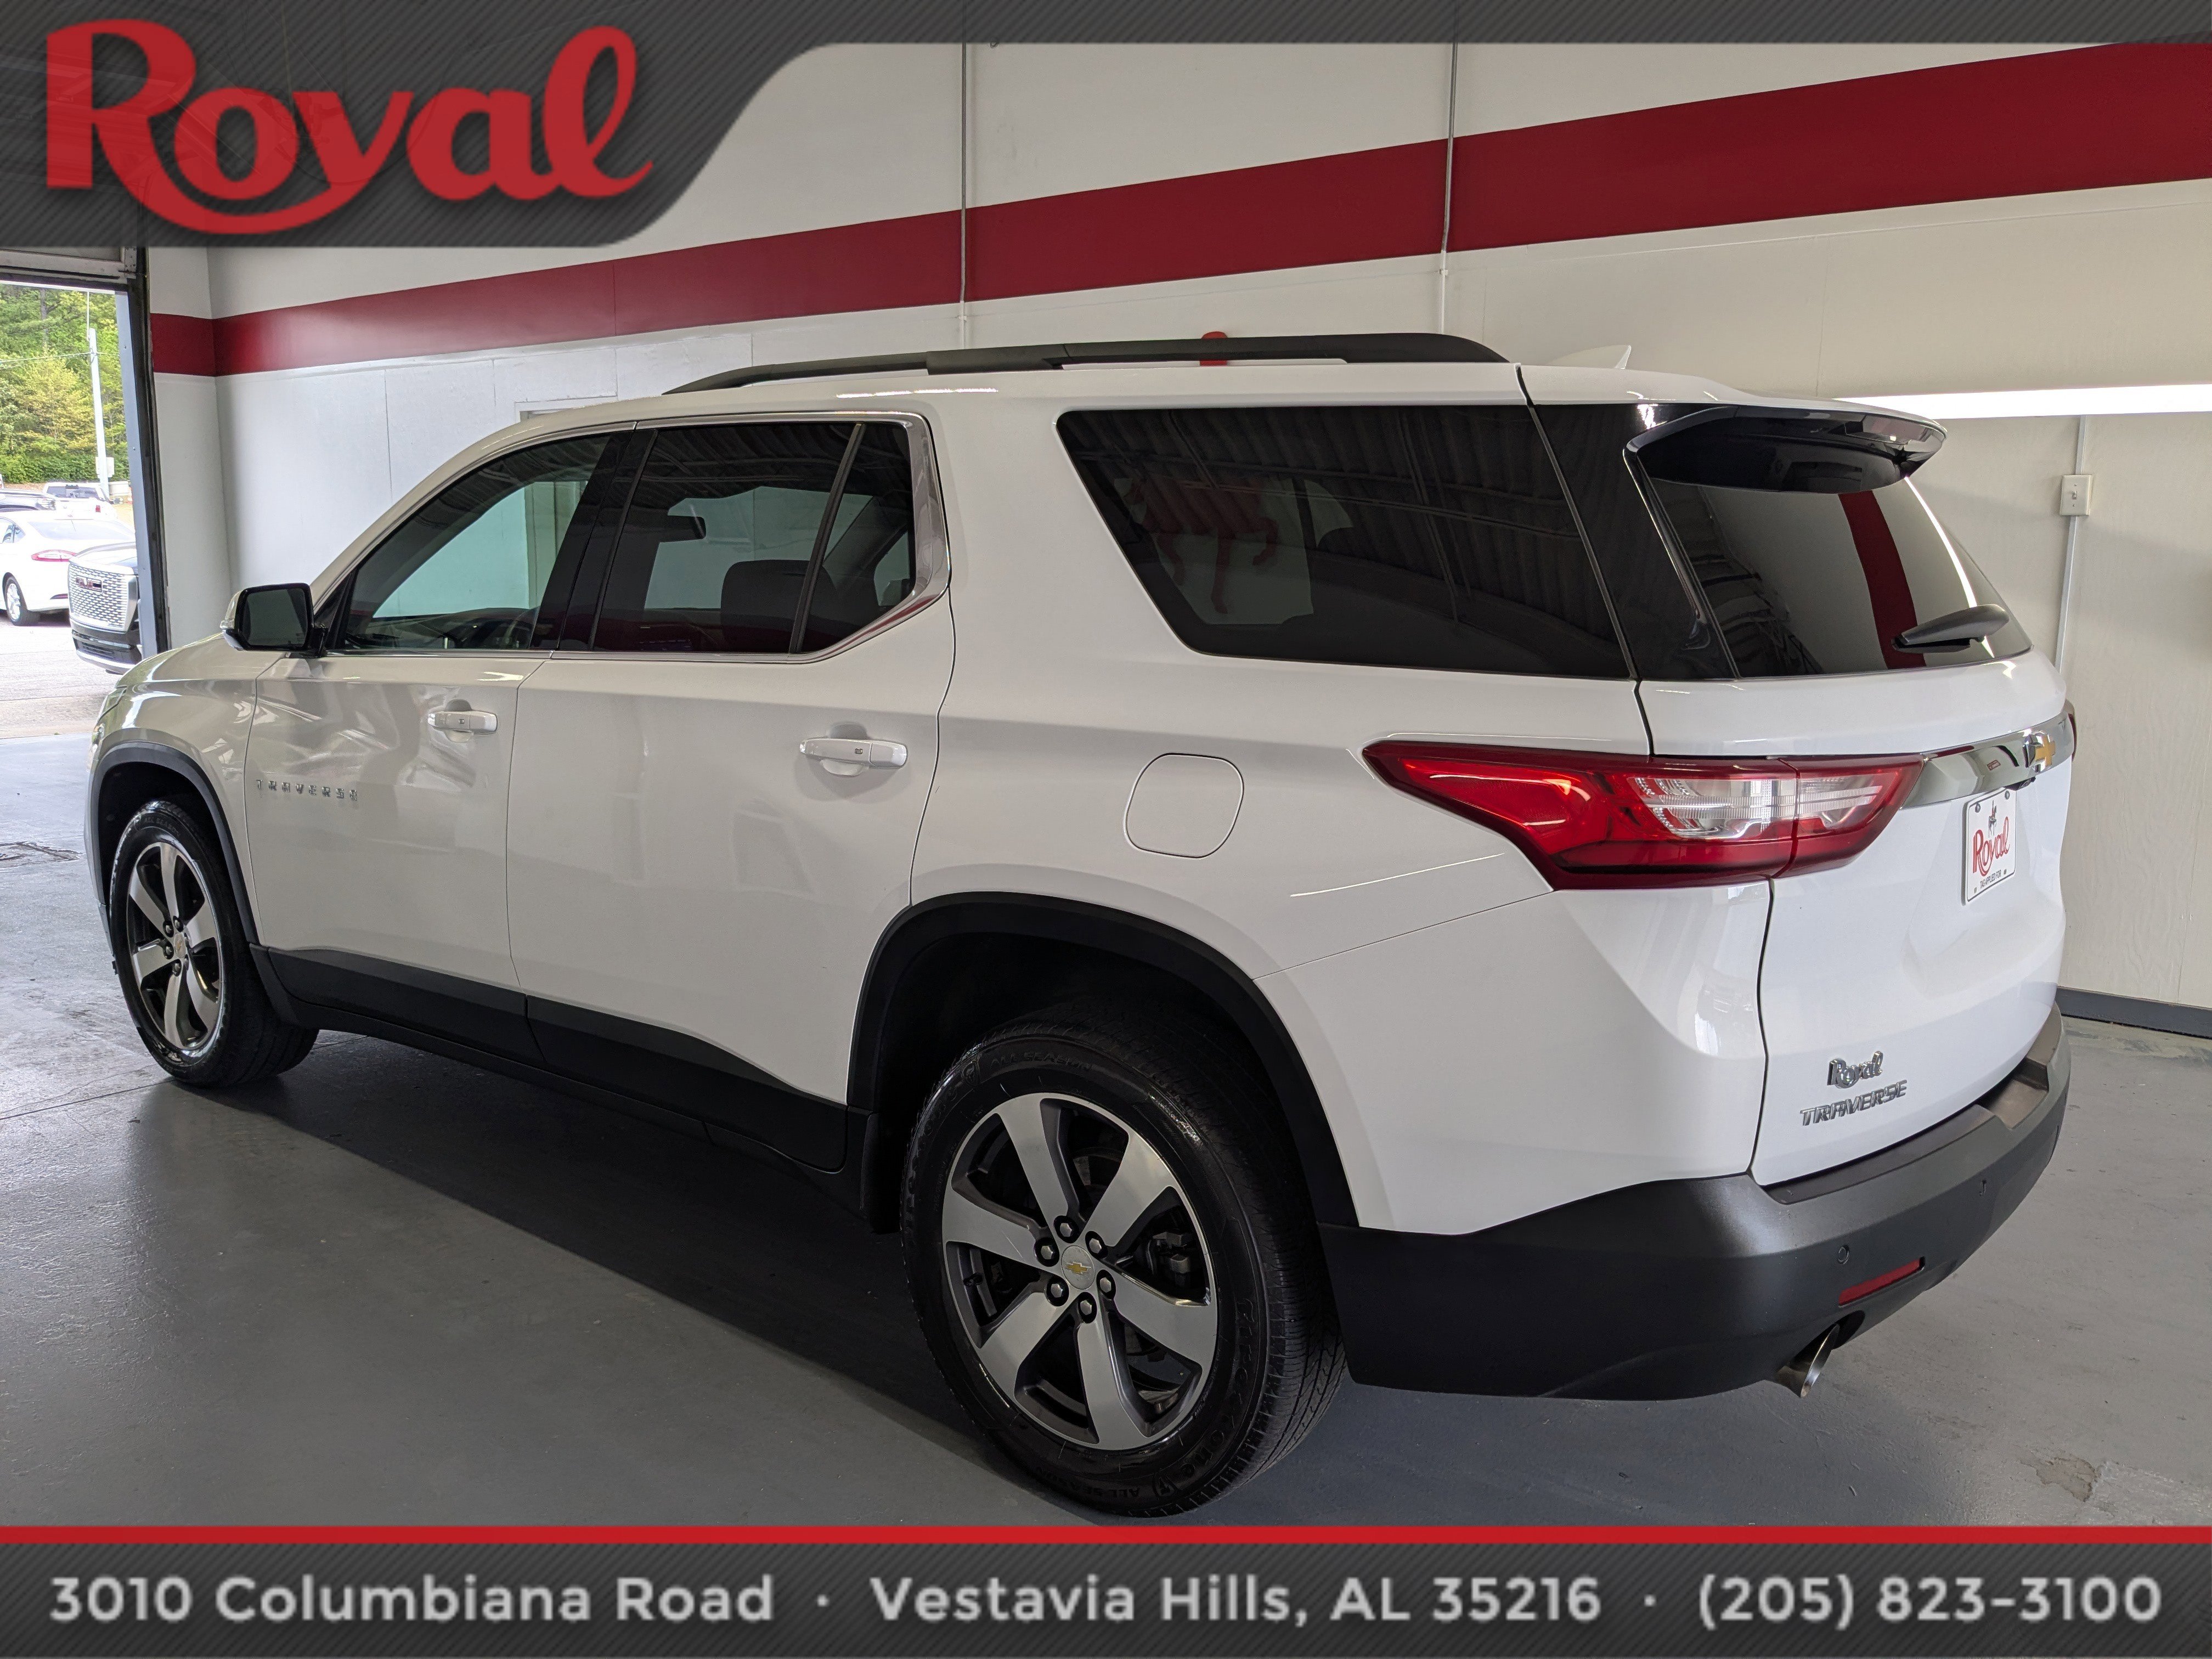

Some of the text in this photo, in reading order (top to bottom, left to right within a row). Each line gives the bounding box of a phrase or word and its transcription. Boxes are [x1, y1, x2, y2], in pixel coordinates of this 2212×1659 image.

[1972, 816, 2011, 877] Royal
[1827, 1050, 1884, 1089] Royal
[1800, 1079, 1908, 1126] TRAVERSE
